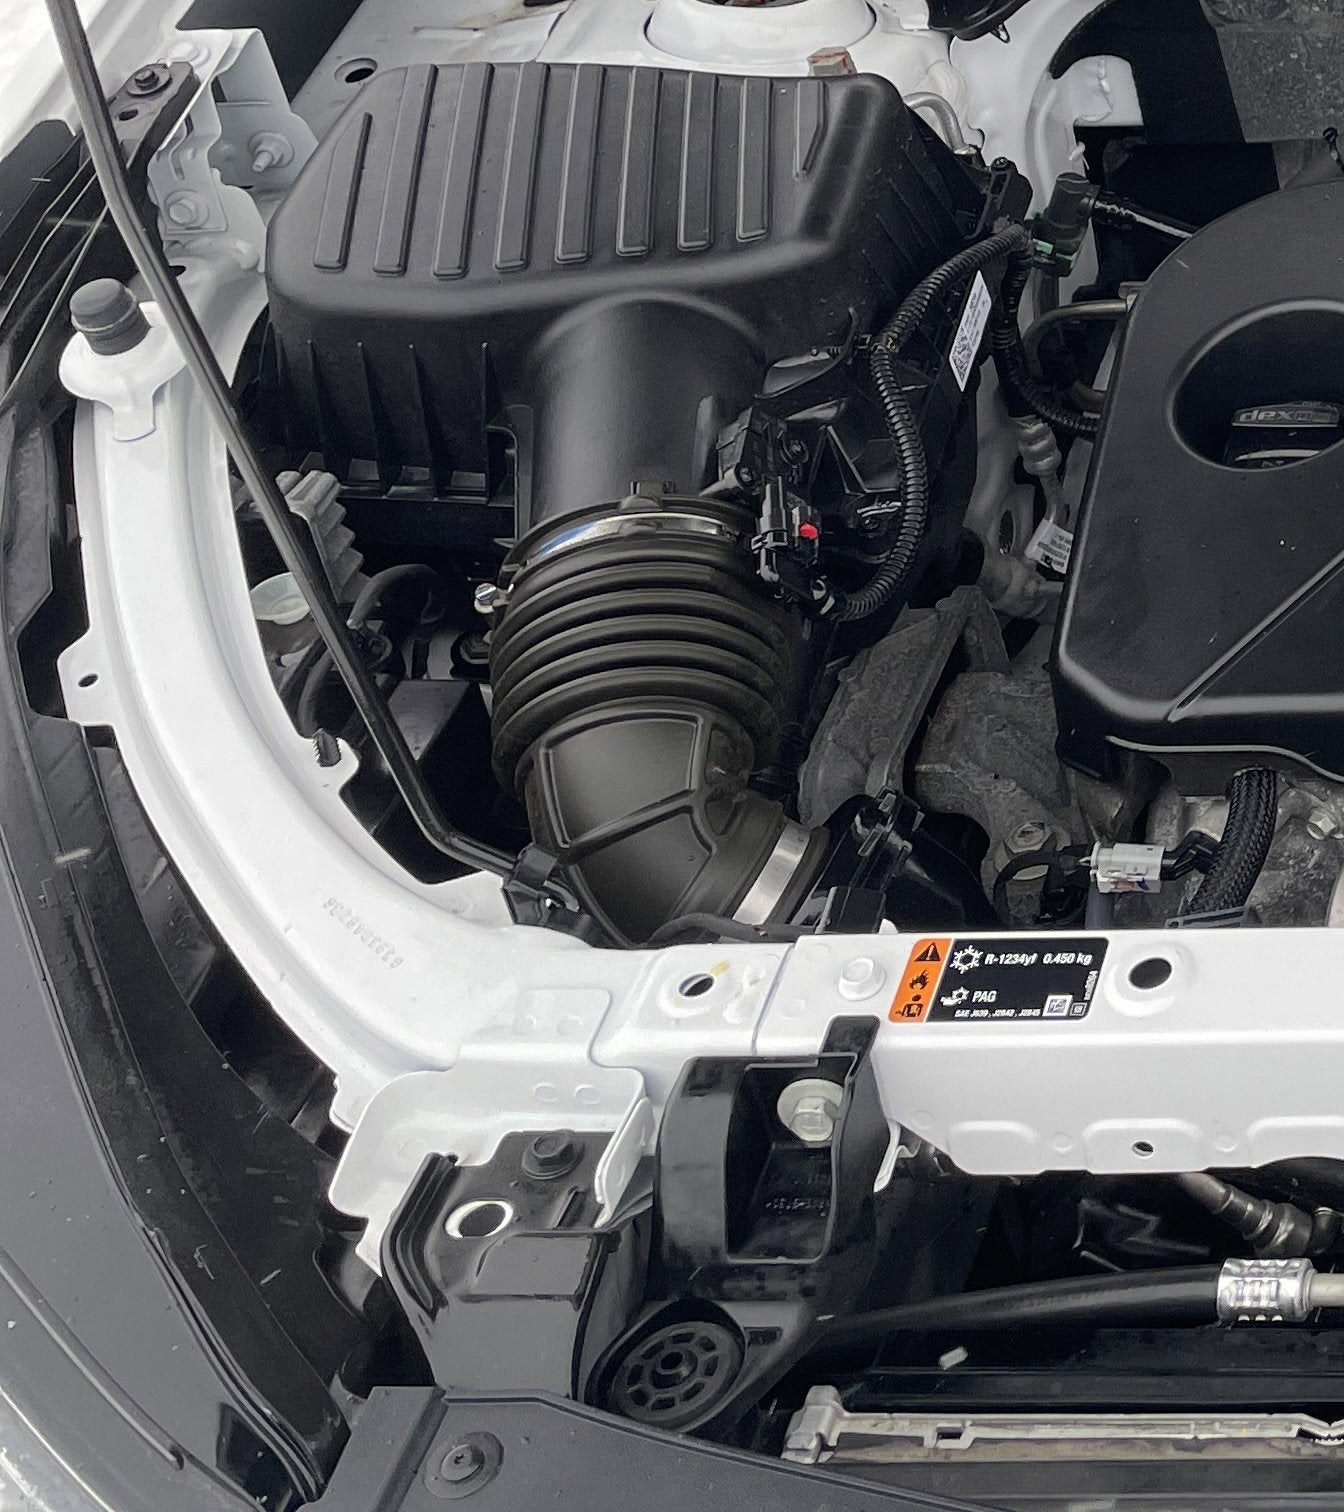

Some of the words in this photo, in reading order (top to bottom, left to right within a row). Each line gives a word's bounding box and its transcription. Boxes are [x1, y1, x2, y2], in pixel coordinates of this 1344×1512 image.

[984, 953, 1037, 967] R-1234yf
[1042, 952, 1075, 965] 0.450
[1076, 953, 1093, 966] kg
[971, 990, 998, 1003] PAG
